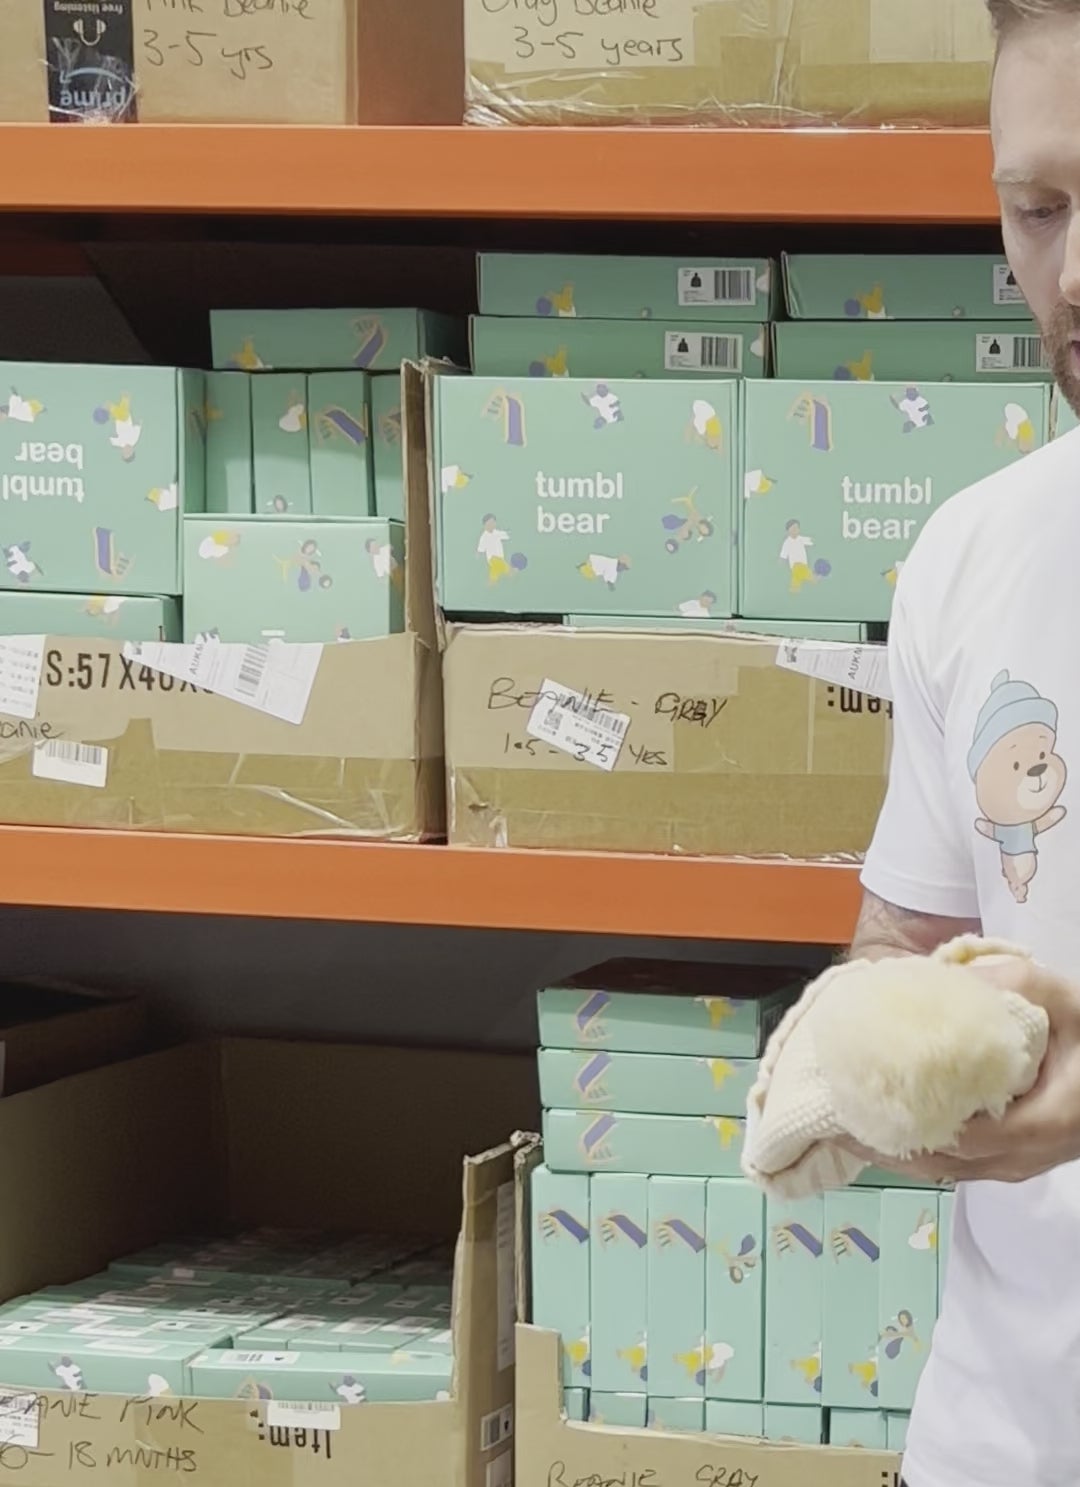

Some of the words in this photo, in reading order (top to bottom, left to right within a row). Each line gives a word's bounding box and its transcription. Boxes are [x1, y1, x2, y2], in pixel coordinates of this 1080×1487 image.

[514, 26, 584, 59] 3-5
[601, 37, 683, 65] years
[15, 442, 83, 469] bear
[2, 475, 84, 502] tumbl
[537, 471, 623, 499] tumbl
[842, 476, 932, 505] tumbl
[537, 506, 610, 535] bear
[842, 511, 916, 540] bear
[0, 720, 67, 739] anie
